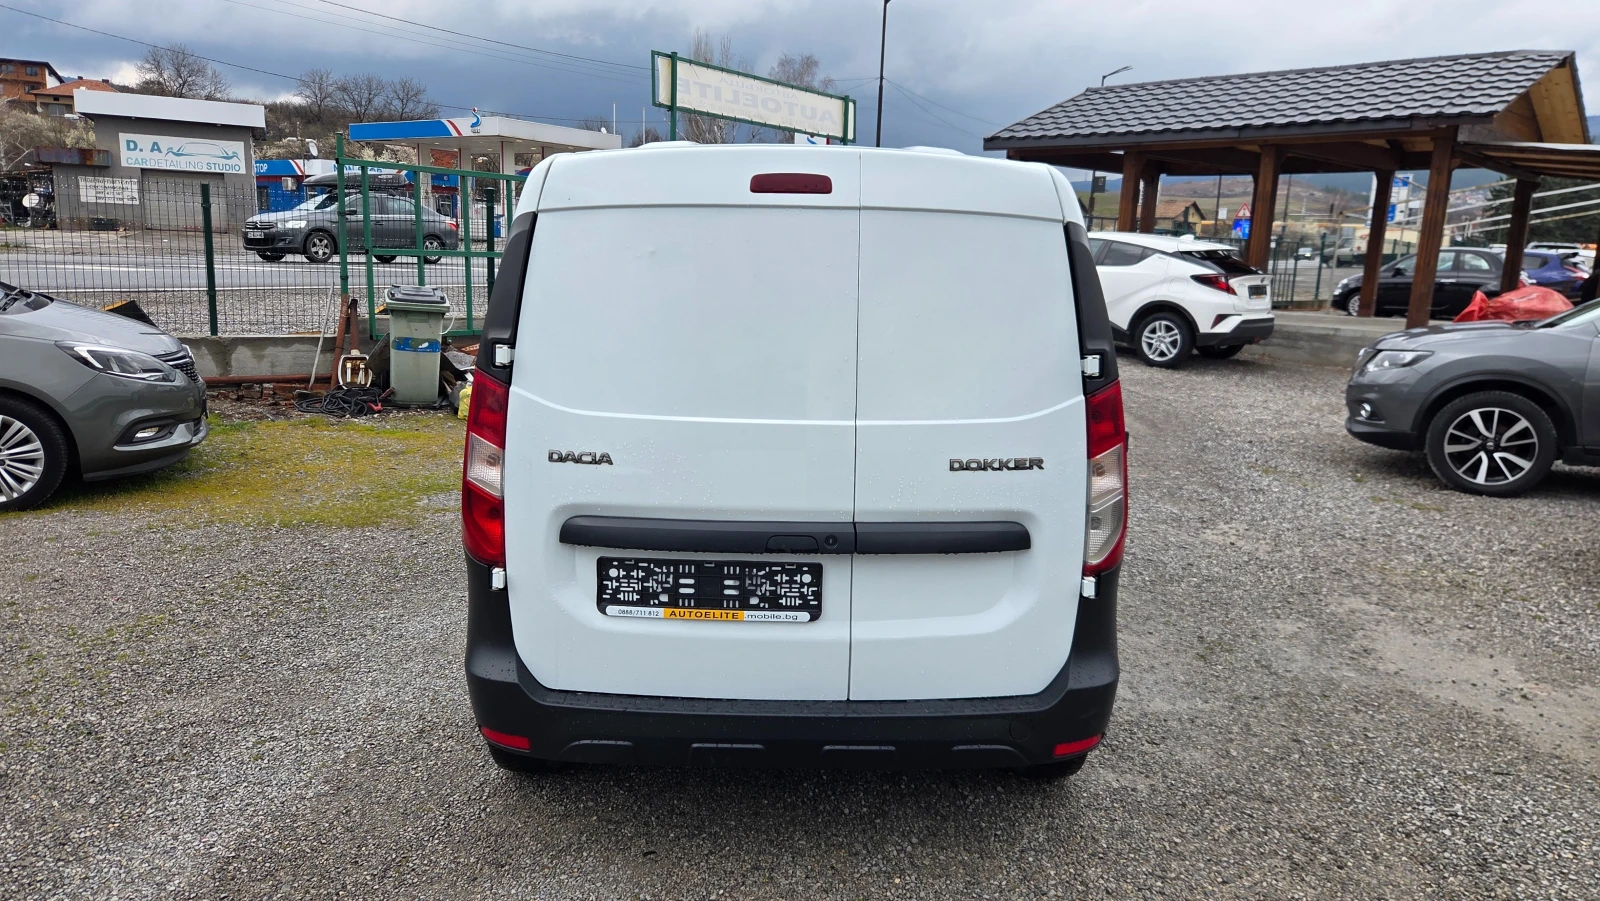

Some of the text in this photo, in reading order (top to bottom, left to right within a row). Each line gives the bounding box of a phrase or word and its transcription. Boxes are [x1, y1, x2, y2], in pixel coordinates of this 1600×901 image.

[150, 142, 162, 153] A
[206, 163, 241, 172] STUDIO
[548, 449, 613, 465] DACIA
[949, 457, 1045, 472] DOKKER
[669, 610, 739, 620] AUTOELITE
